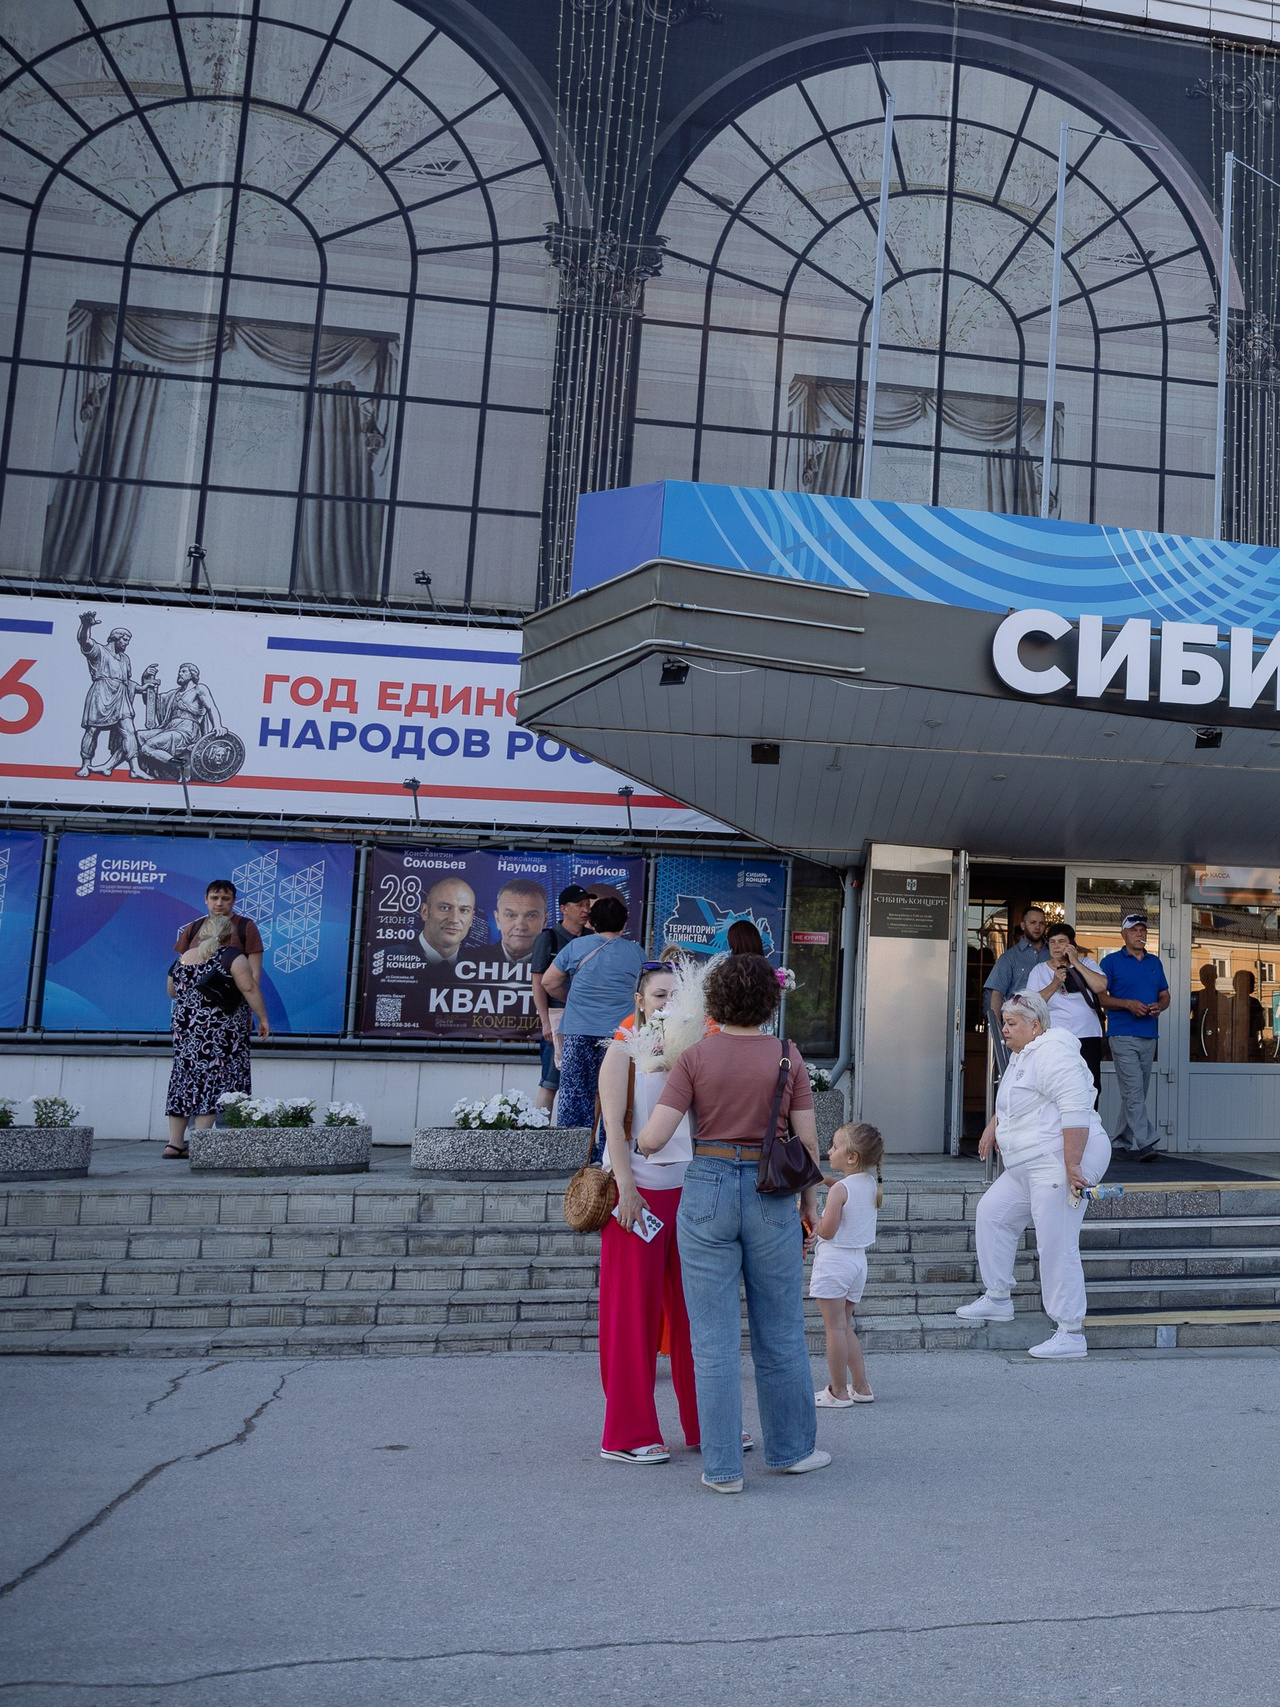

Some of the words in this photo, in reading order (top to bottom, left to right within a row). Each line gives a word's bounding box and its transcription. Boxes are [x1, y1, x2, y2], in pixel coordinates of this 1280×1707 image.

[262, 673, 358, 714] ГОД
[258, 716, 491, 761] НАРОДОВ
[404, 849, 453, 858] Константин
[499, 855, 543, 863] Александр
[101, 859, 157, 871] СИБИРЬ
[403, 857, 466, 870] Соловьев
[497, 861, 547, 873] Наумов
[574, 865, 626, 877] Грибков
[100, 871, 167, 884] КОНЦЕРТ
[379, 874, 422, 913] 28
[376, 928, 415, 940] 18:00
[668, 924, 716, 935] ТЕРРИТОРИЯ
[668, 933, 708, 943] ЕДИНСТВА
[386, 954, 421, 962] СИБИРЬ
[386, 962, 427, 970] КОНЦЕРТ
[428, 988, 538, 1015] КВАРТ
